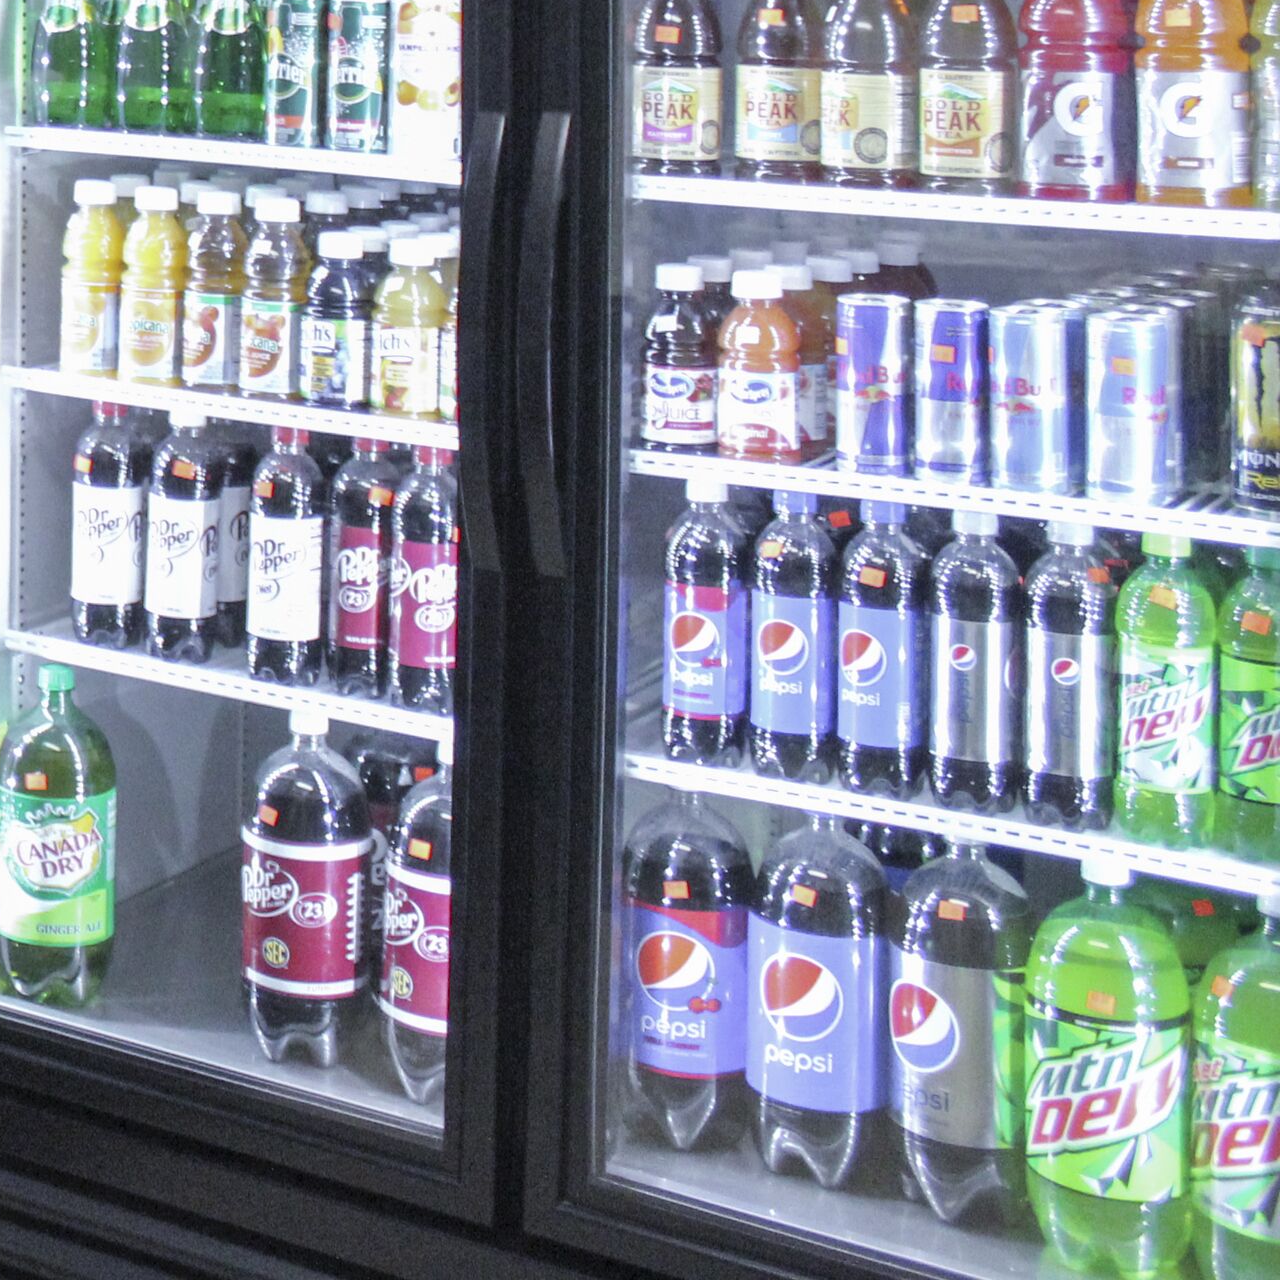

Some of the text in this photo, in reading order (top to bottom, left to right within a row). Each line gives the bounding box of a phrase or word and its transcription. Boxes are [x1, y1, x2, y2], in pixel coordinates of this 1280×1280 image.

[642, 101, 695, 121] PEAK
[745, 101, 798, 121] PEAK
[924, 99, 981, 111] GOLD
[924, 111, 982, 133] PEAK
[670, 668, 714, 689] pepsi
[842, 687, 881, 708] pepsi
[16, 827, 104, 864] CANADA
[41, 855, 84, 881] DRY
[36, 922, 82, 937] GINGER
[641, 1014, 707, 1042] pepsi
[764, 1043, 834, 1075] pepsi
